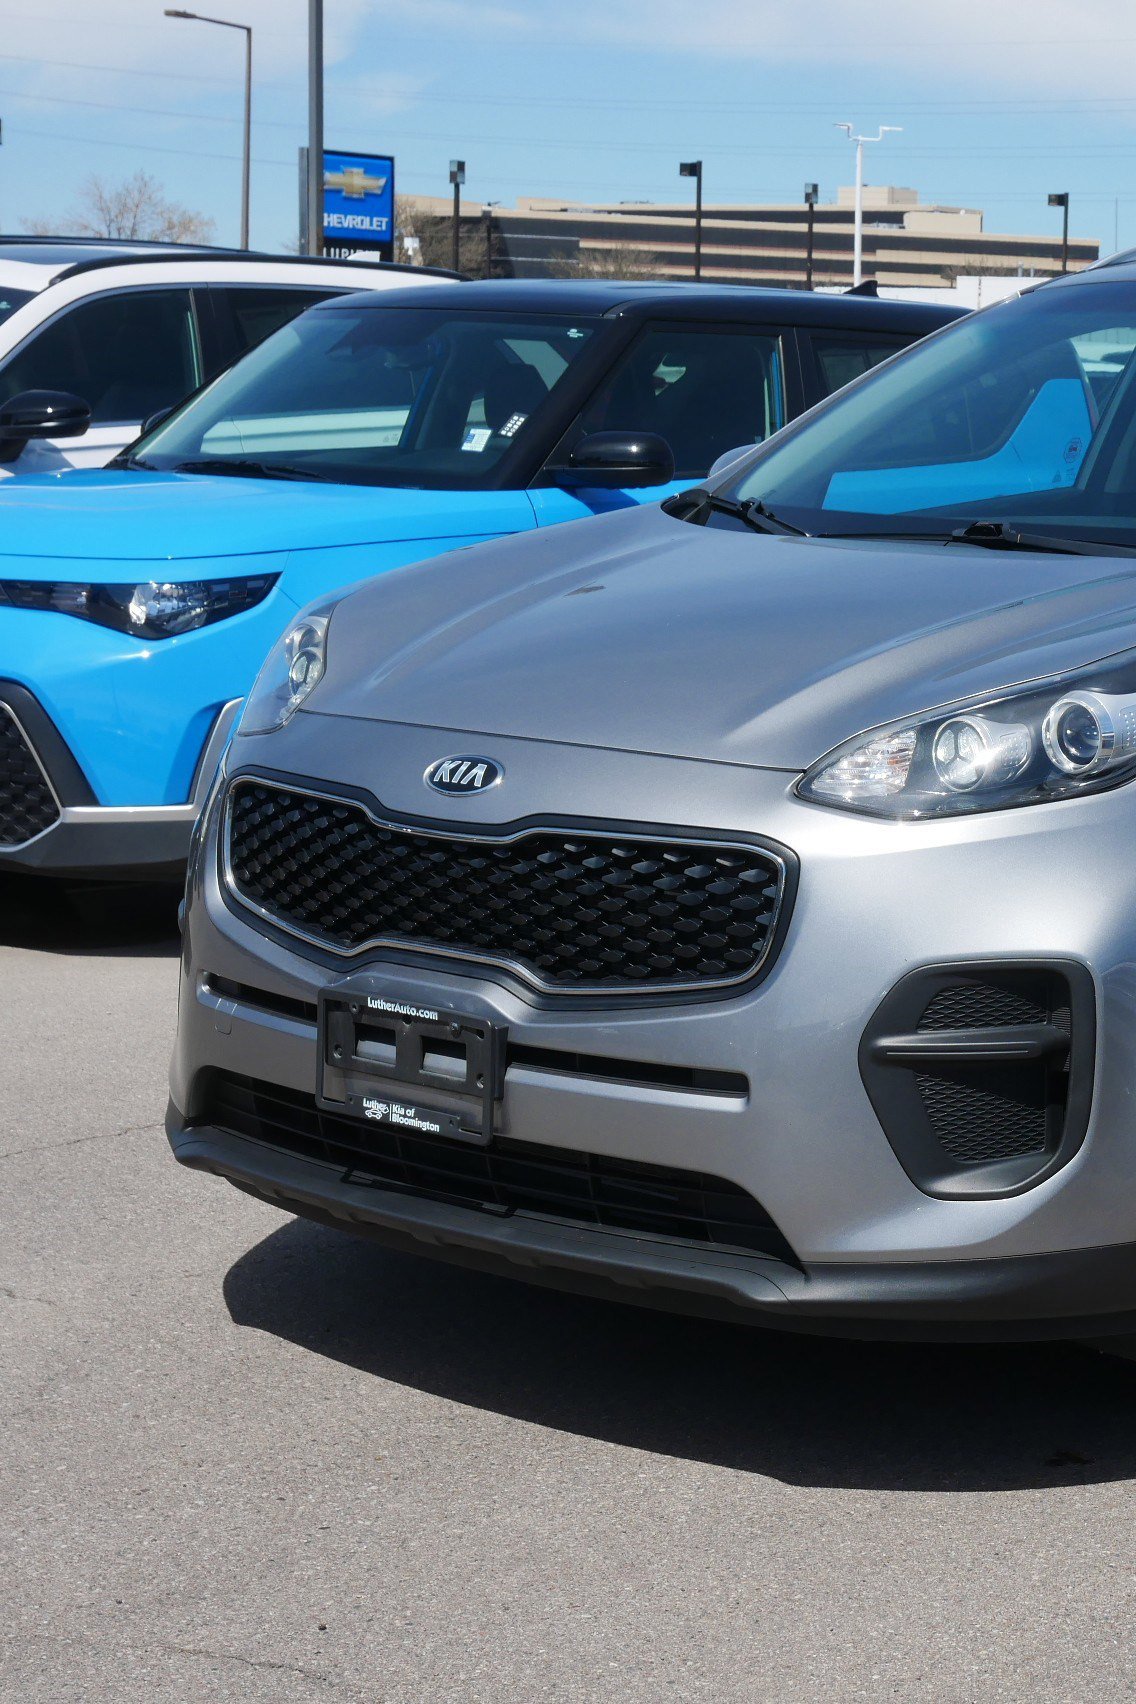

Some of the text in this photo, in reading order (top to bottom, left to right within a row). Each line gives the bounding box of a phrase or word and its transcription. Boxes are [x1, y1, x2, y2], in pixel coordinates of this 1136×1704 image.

[323, 212, 388, 231] HEVROLET
[433, 760, 488, 788] KIA
[367, 996, 439, 1021] LutherAuto.com
[362, 1097, 387, 1112] Luther
[392, 1104, 416, 1118] Kia of
[391, 1113, 440, 1133] Bloomington
